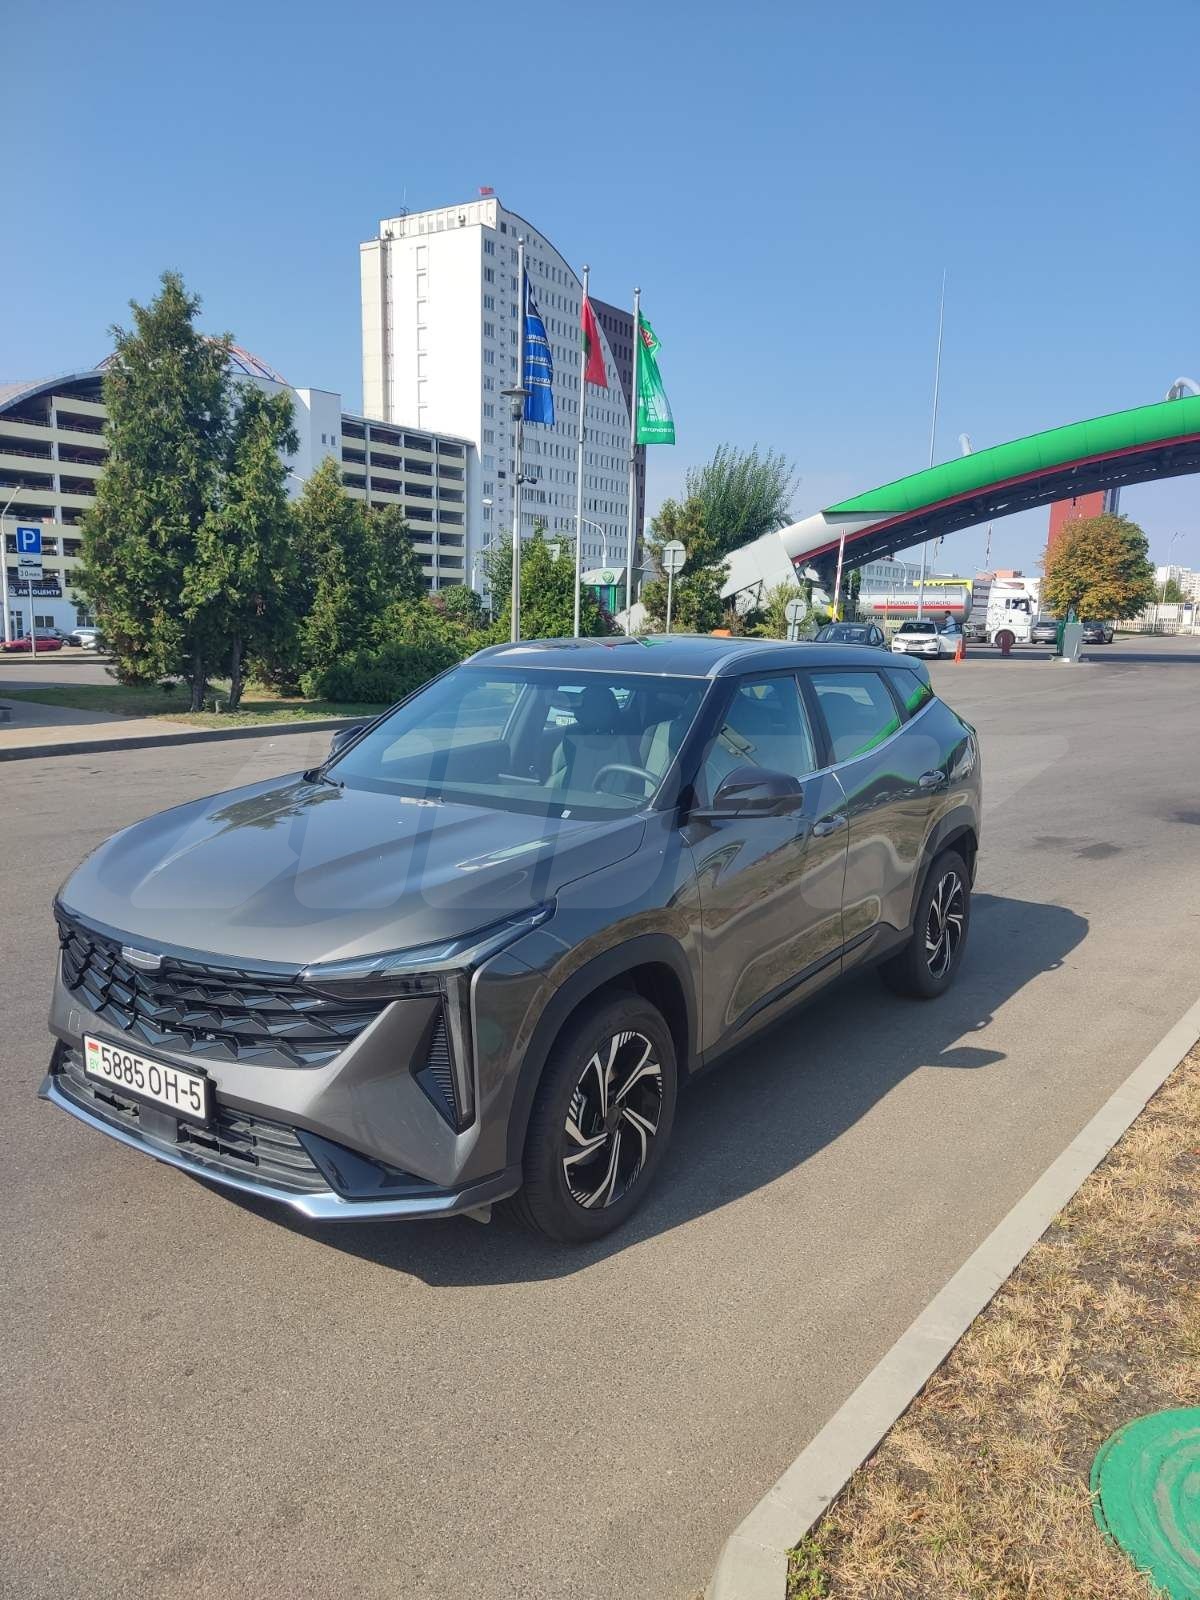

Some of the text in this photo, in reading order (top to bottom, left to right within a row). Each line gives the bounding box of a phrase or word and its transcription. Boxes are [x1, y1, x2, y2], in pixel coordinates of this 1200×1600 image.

[22, 530, 36, 551] P
[89, 1058, 99, 1070] BY
[101, 1046, 201, 1111] 5885 OH-5
